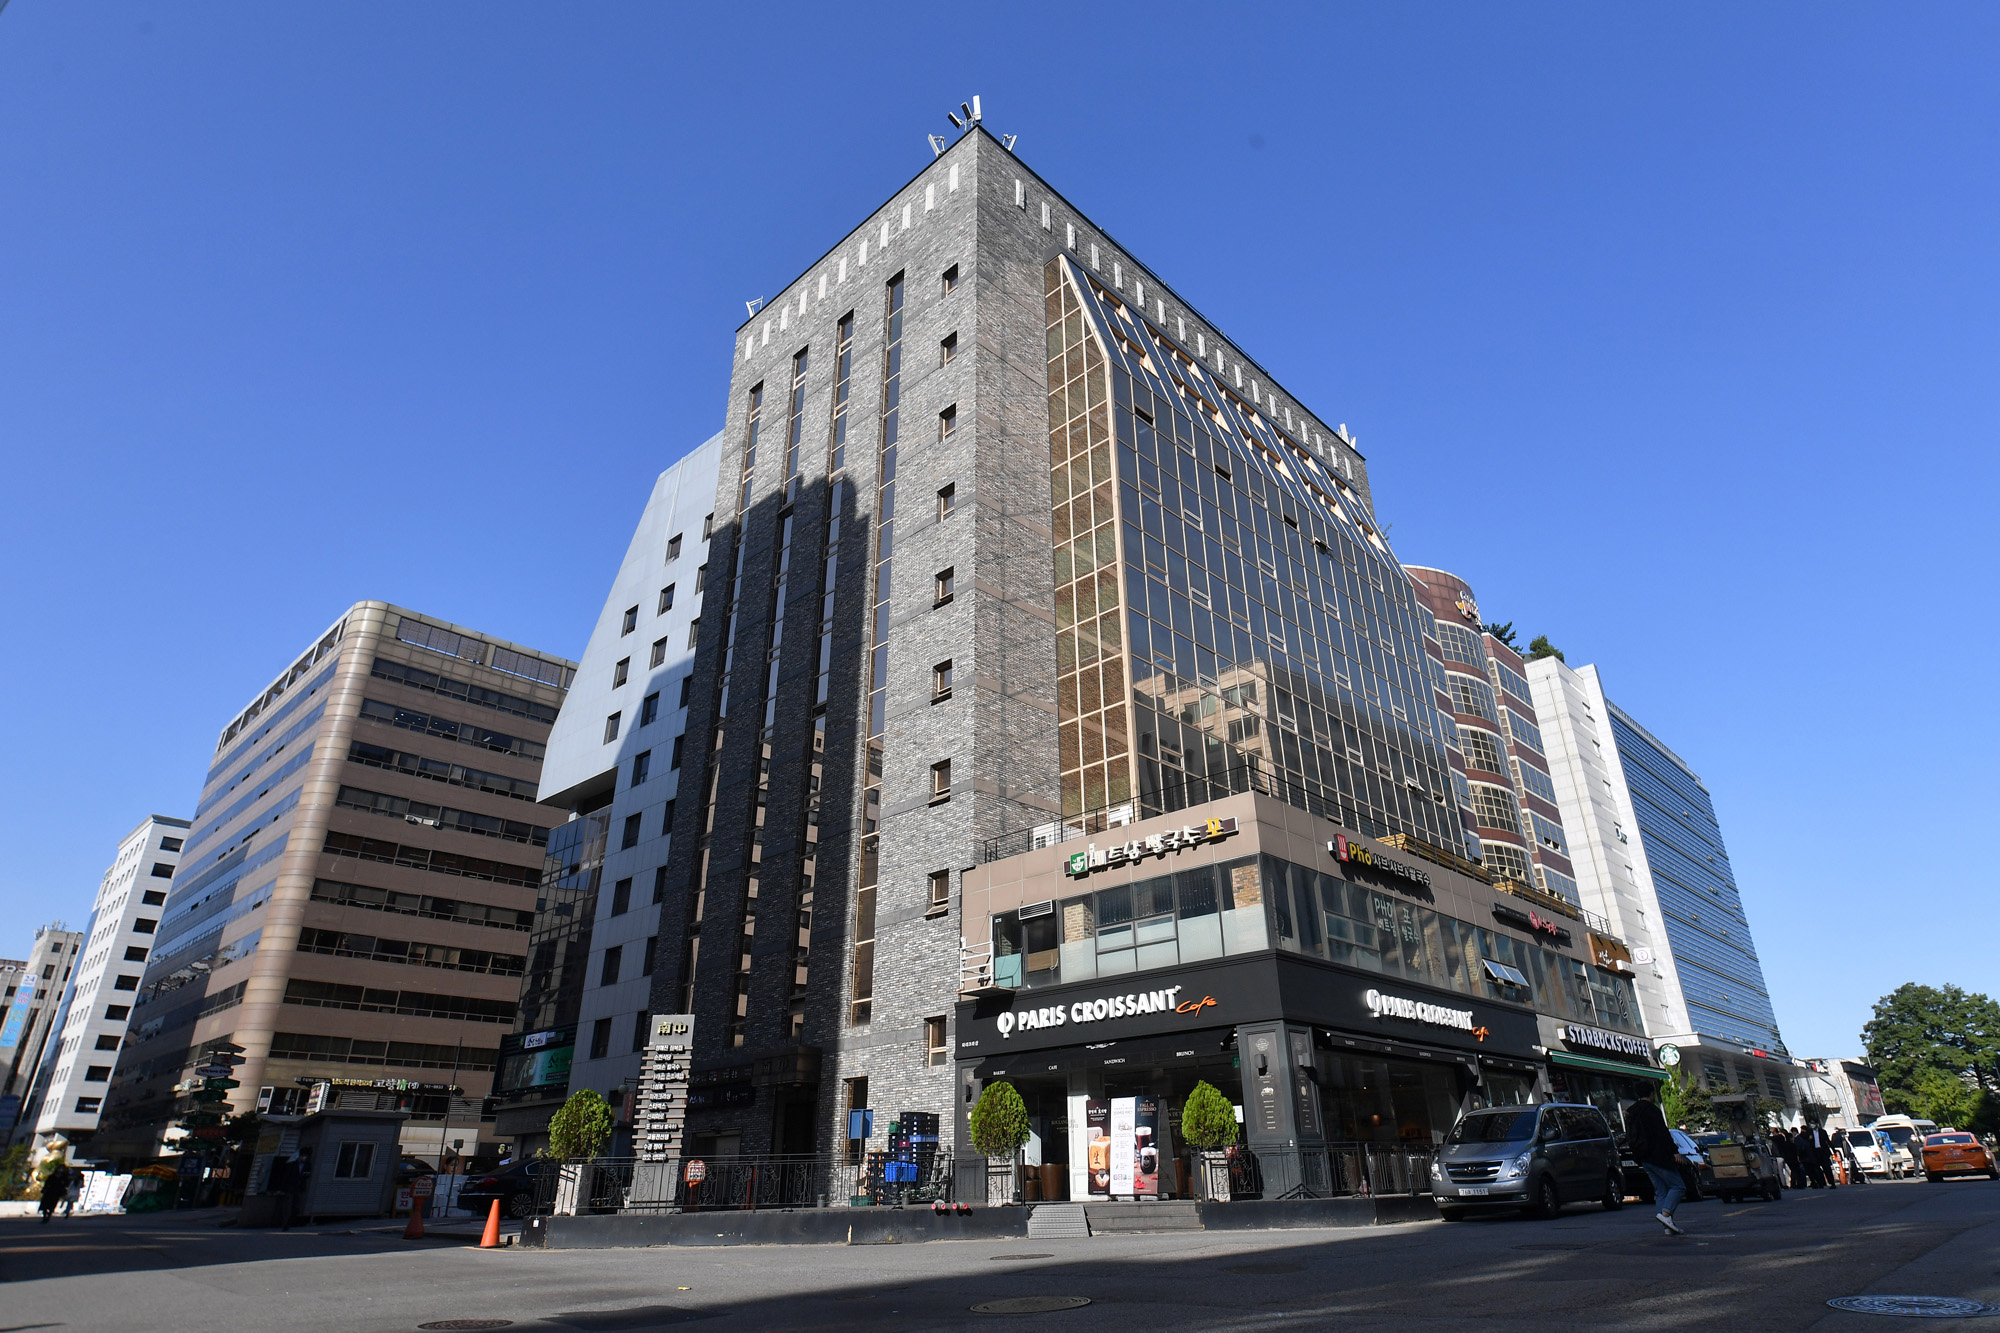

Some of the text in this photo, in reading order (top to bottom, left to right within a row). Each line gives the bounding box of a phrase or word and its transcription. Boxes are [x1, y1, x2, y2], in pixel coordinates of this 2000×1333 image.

[1089, 817, 1224, 868] 베트남 쌀국수 포
[1377, 917, 1420, 945] 베트남 쌀국수
[1018, 1005, 1067, 1032] PARIS
[1070, 985, 1182, 1023] CROISSANT
[1381, 994, 1417, 1020] PARIS
[1416, 1001, 1473, 1031] CROISSANT
[657, 1021, 687, 1034] 南中
[1568, 1025, 1652, 1057] STARBUCKS COFFEE
